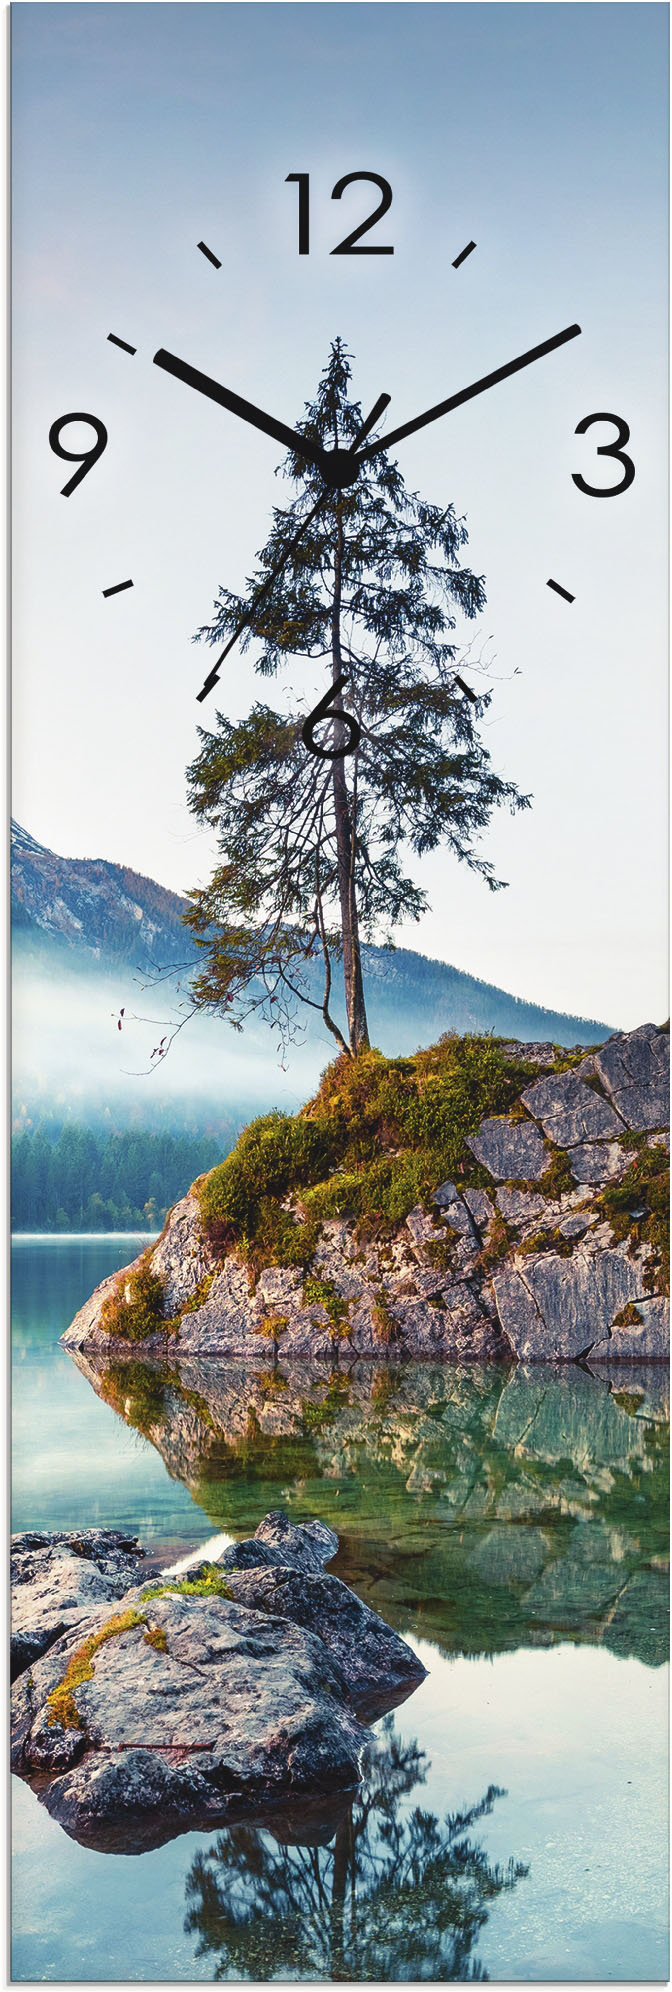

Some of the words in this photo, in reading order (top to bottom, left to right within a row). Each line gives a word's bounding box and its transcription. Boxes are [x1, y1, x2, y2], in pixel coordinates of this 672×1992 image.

[285, 171, 394, 255] 12
[48, 412, 108, 498] 9
[571, 412, 636, 498] 3
[302, 674, 361, 760] 6
